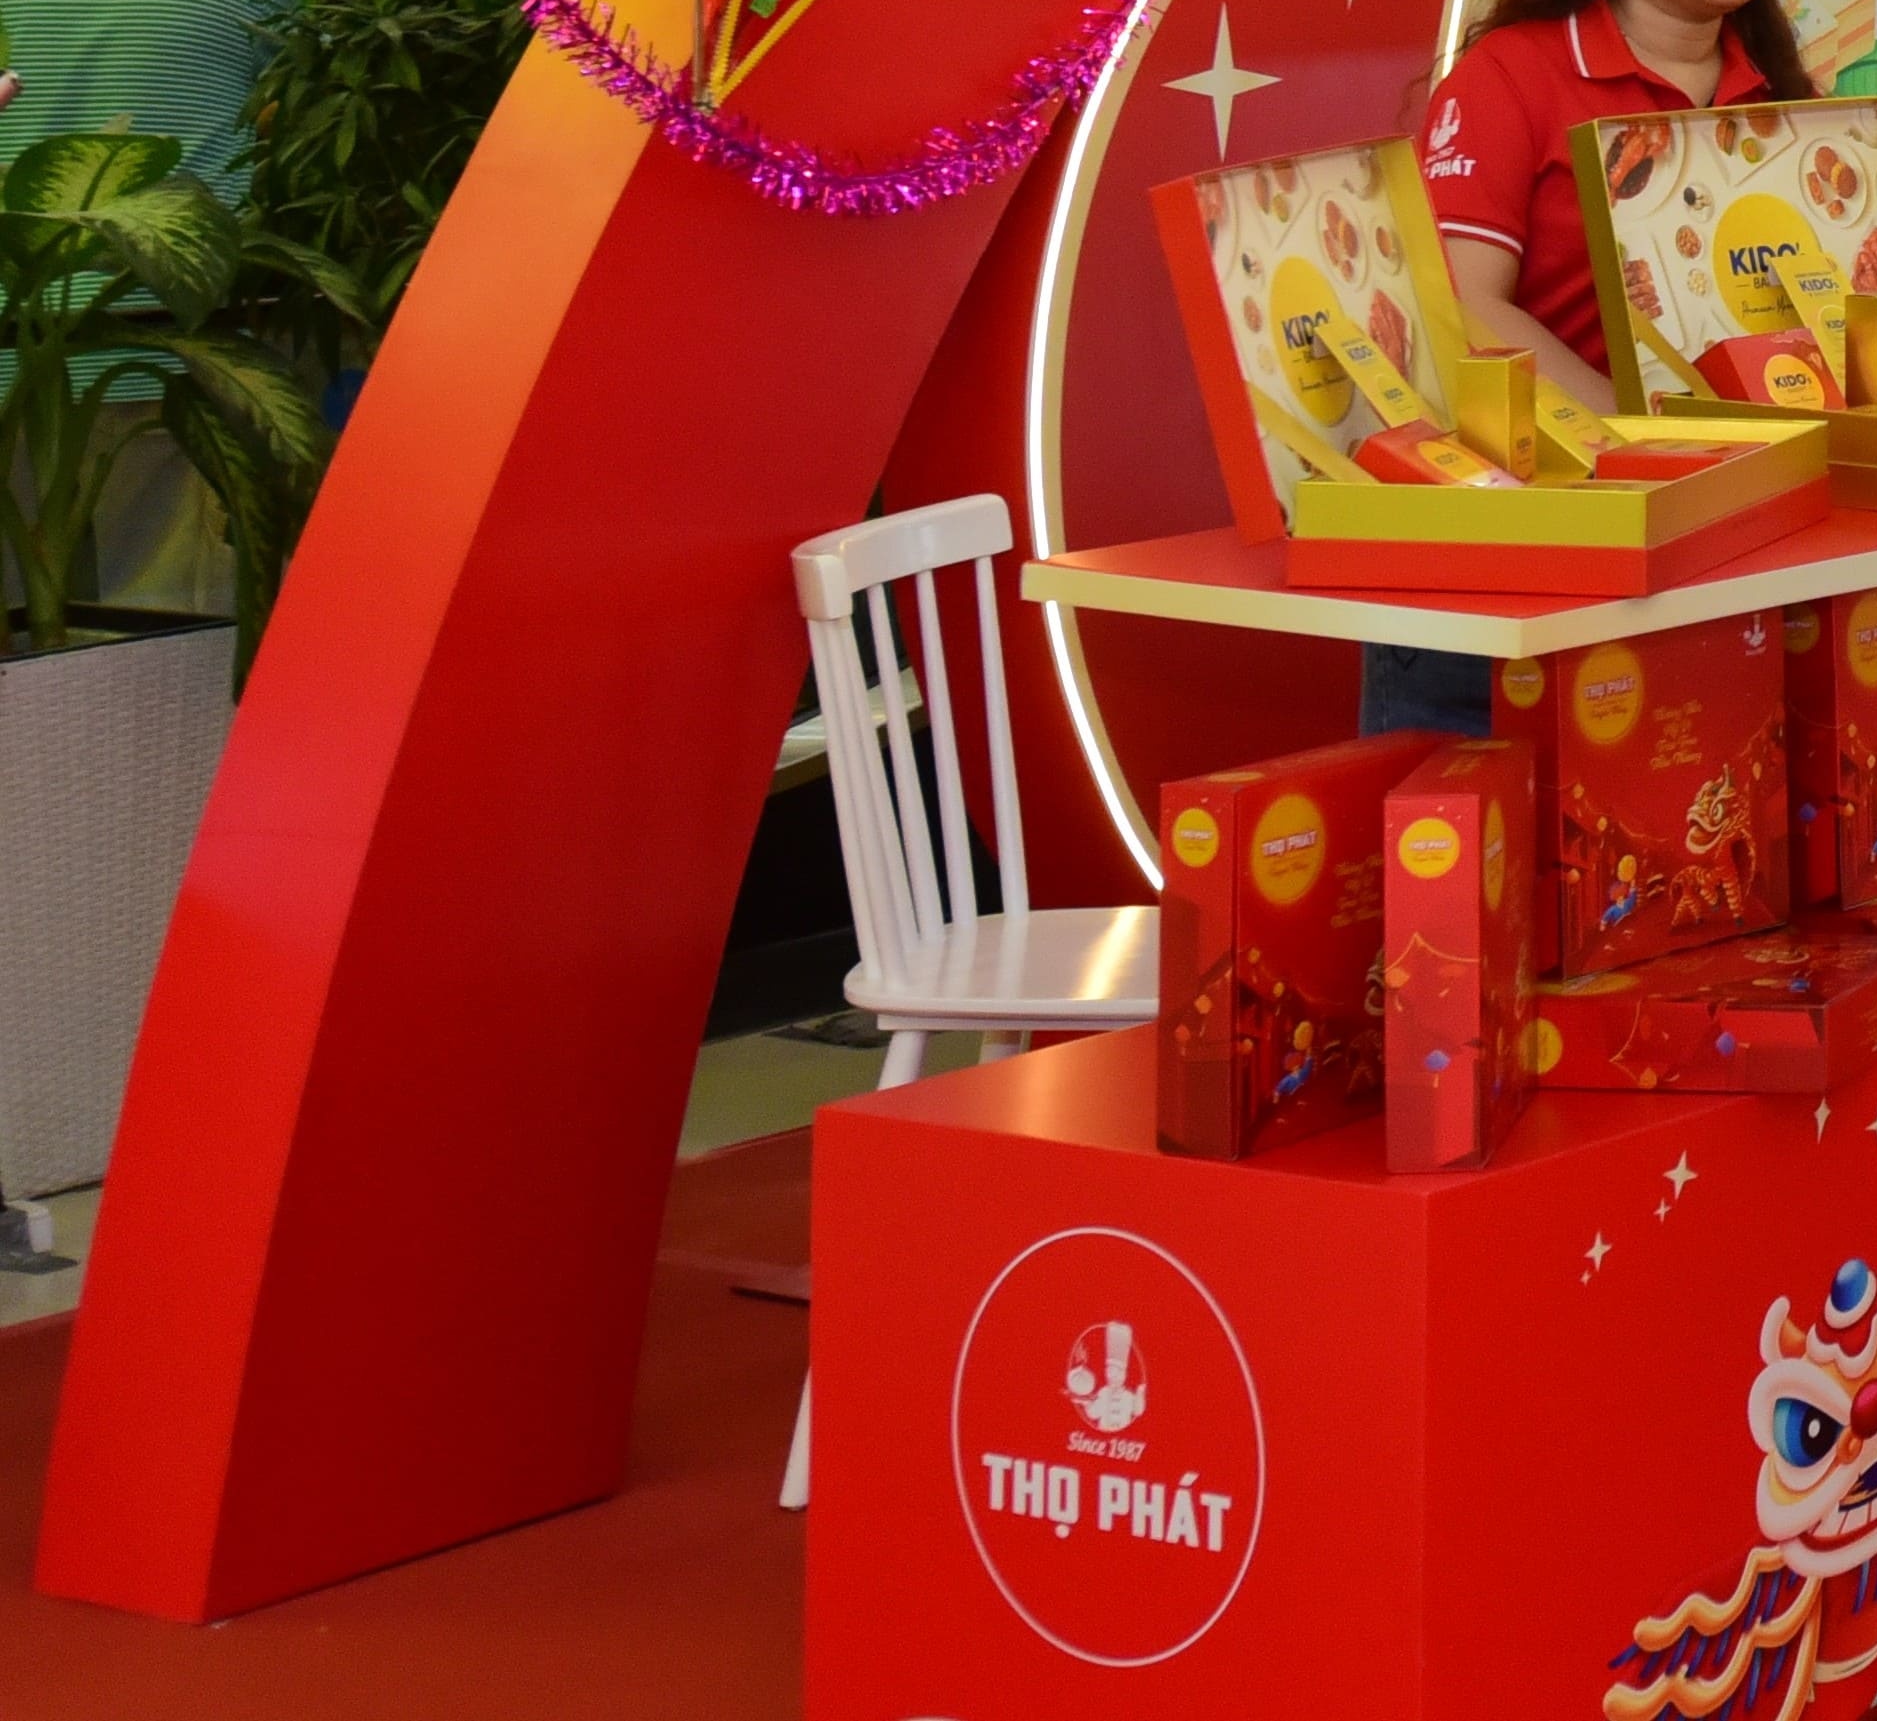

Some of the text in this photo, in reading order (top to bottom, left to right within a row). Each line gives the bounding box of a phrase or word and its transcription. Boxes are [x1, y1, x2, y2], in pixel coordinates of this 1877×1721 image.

[1067, 1431, 1147, 1464] Since 1987
[981, 1452, 1233, 1553] THỌ PHÁT
